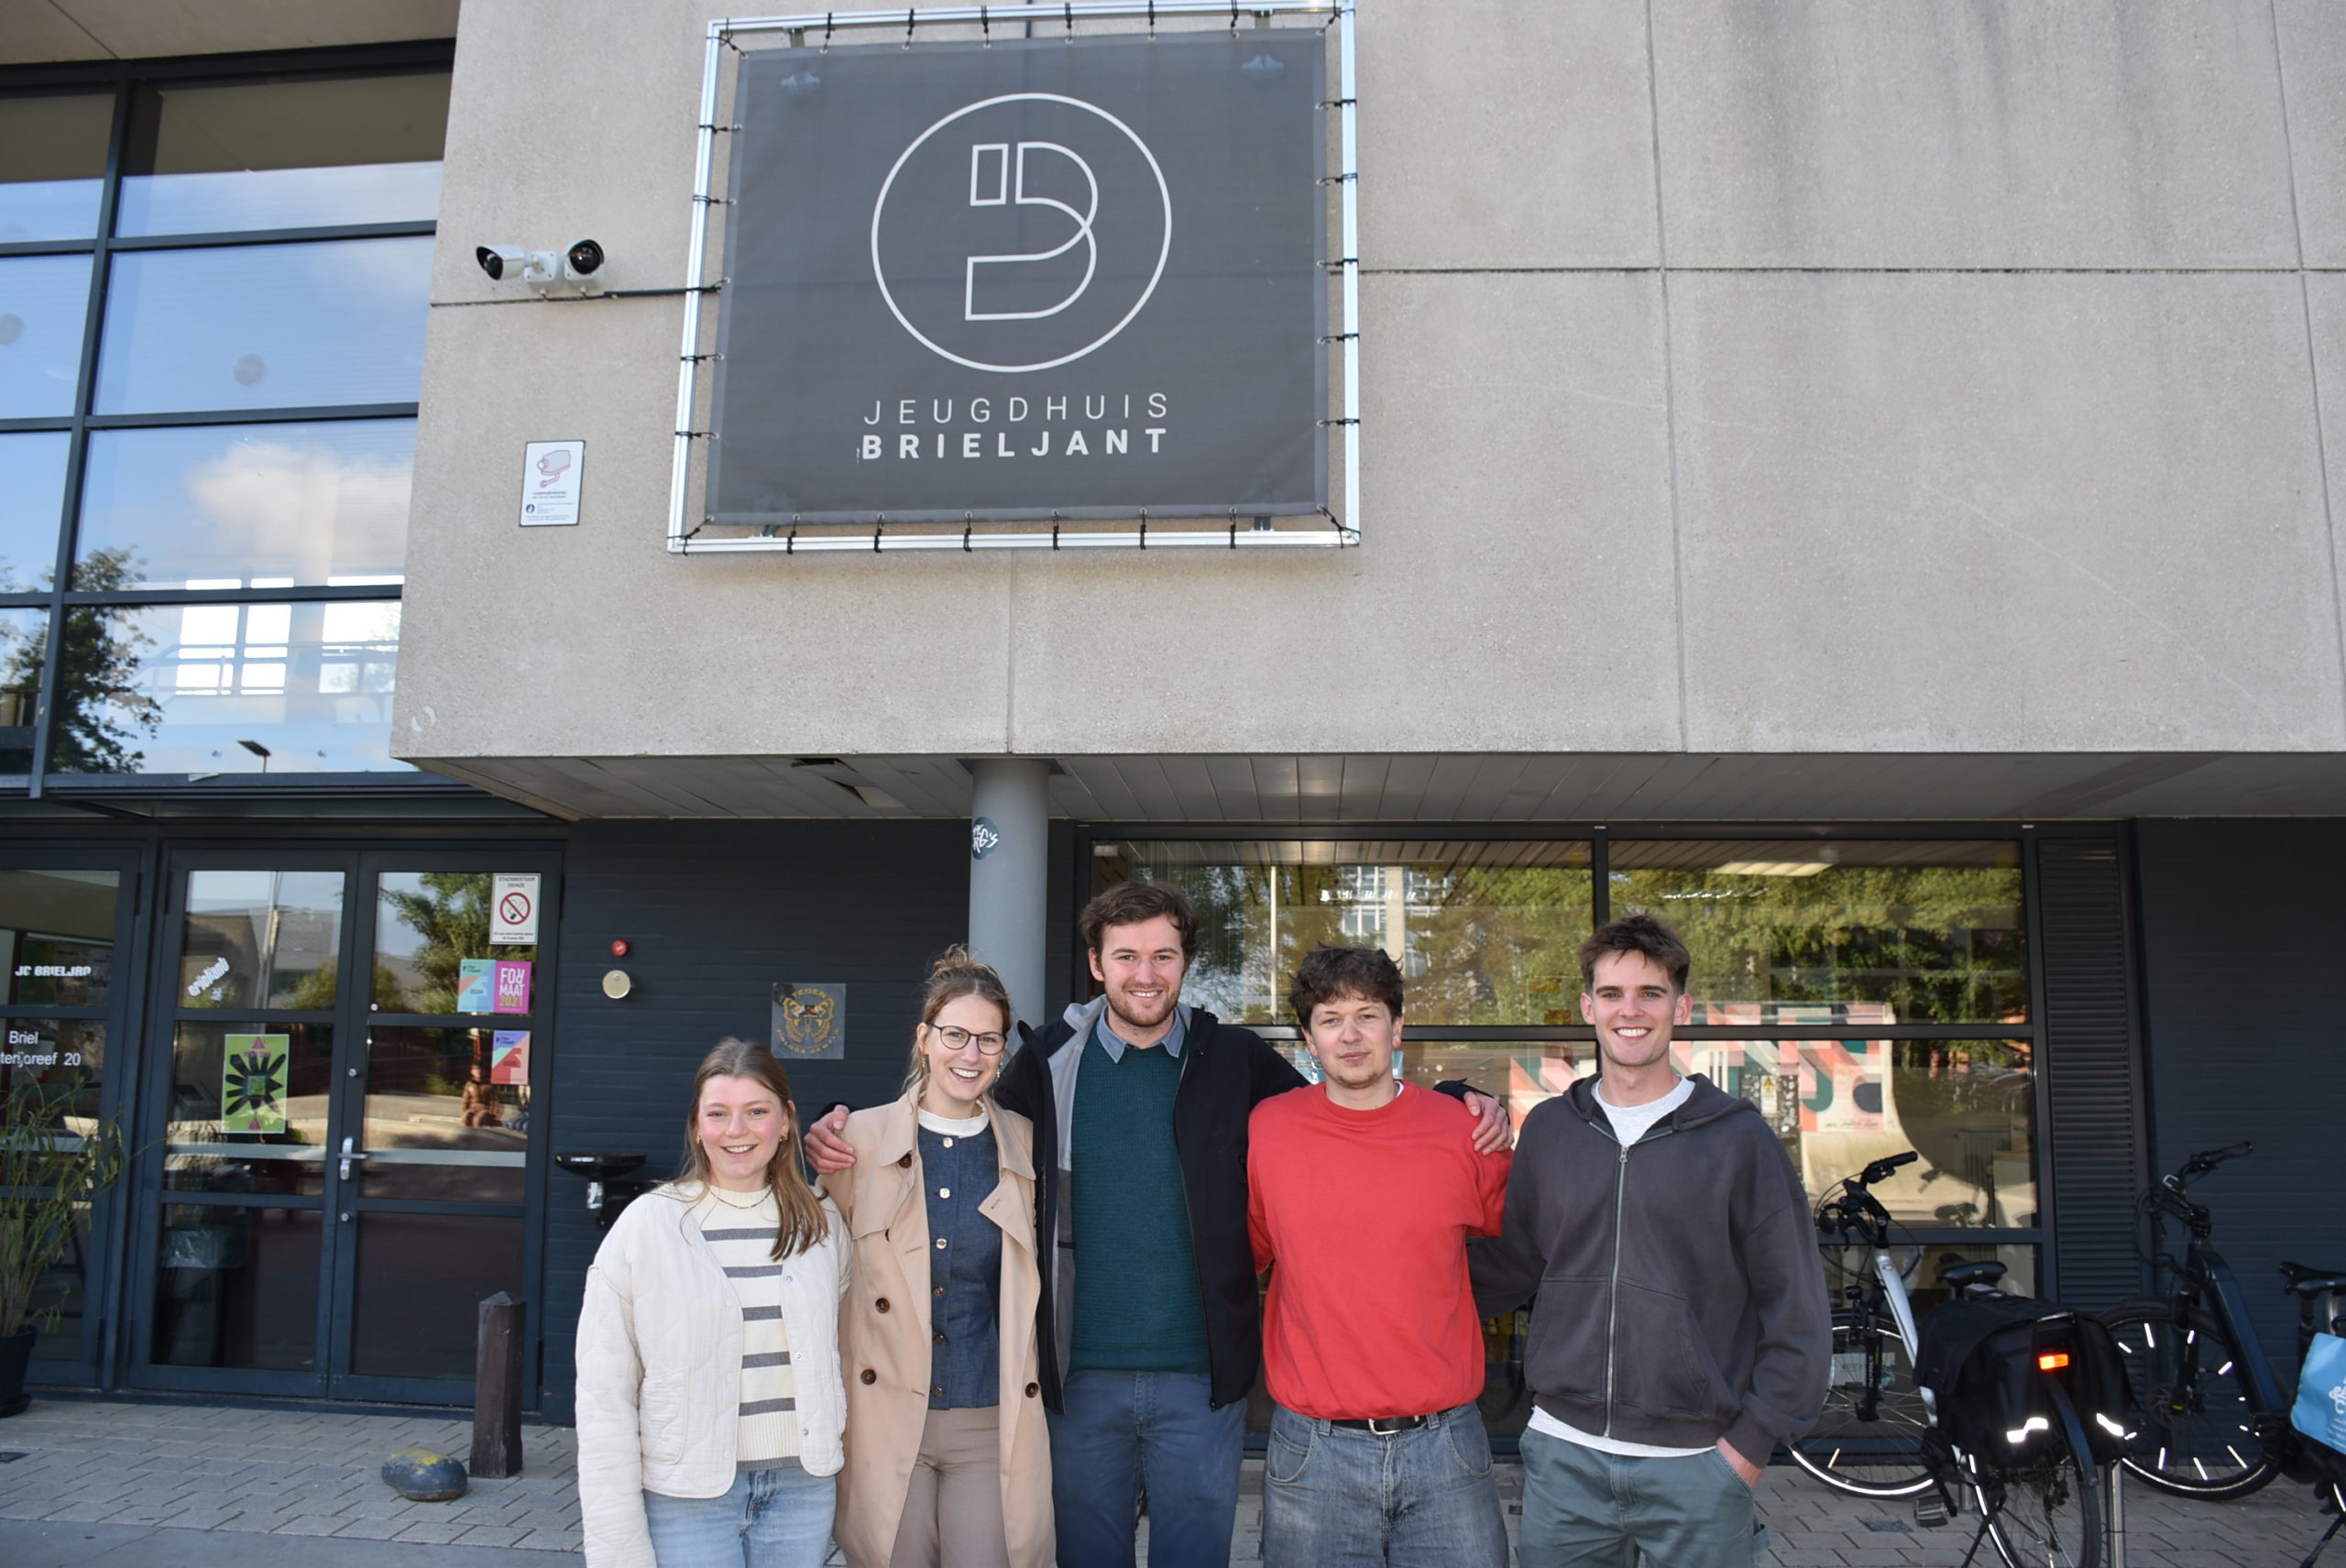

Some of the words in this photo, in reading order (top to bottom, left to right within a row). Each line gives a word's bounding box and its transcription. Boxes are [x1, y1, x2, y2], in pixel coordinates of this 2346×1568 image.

[864, 392, 1168, 424] JEUGDHUIS
[861, 428, 1167, 459] BRIELJANT
[499, 984, 525, 996] MAAT
[499, 996, 523, 1007] 2021
[8, 1030, 38, 1045] Briel
[63, 1052, 81, 1066] 20
